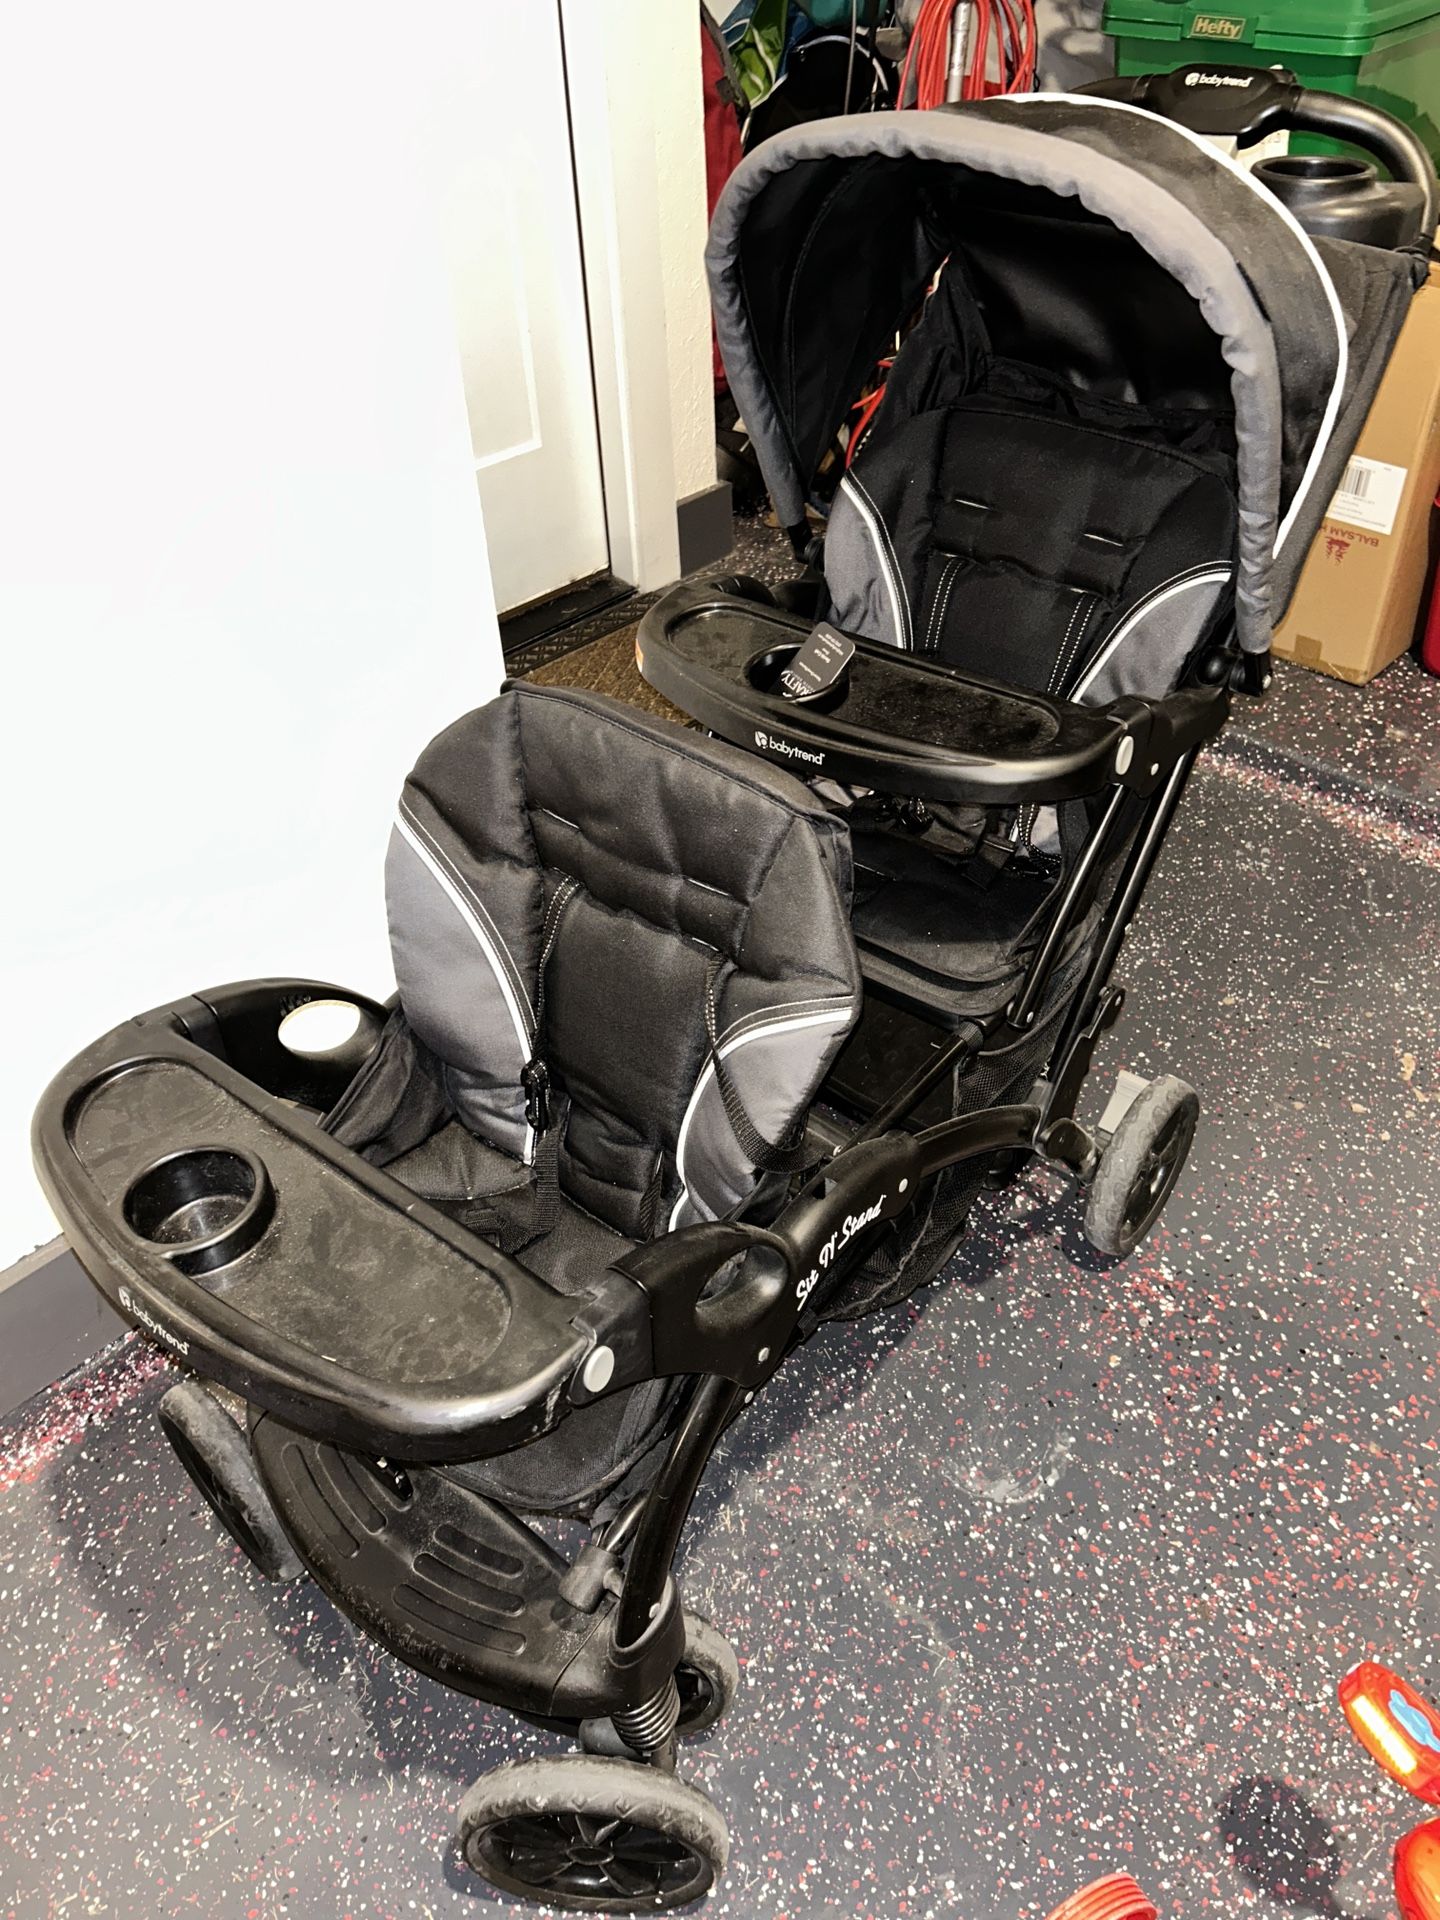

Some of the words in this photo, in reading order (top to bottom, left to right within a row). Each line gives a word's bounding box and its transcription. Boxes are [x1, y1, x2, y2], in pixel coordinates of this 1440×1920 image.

[1195, 18, 1241, 38] Hefty
[1199, 73, 1252, 88] babytrend
[1329, 526, 1379, 547] BALSAM
[769, 736, 824, 765] babytrend
[796, 1270, 819, 1311] Sit
[838, 1194, 884, 1250] Stand
[132, 1300, 188, 1355] babytrend
